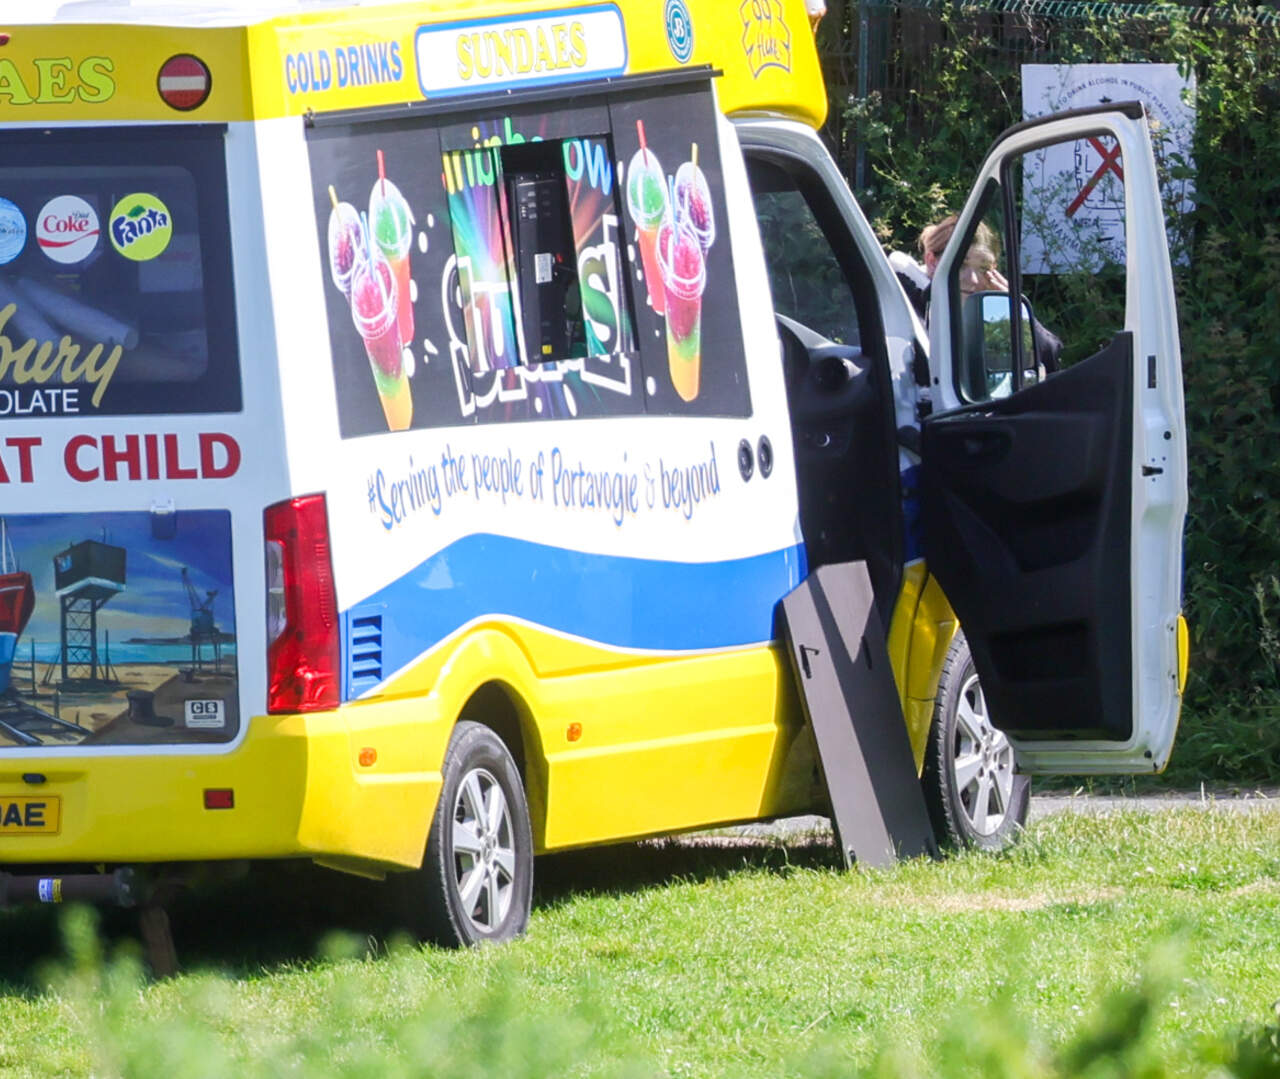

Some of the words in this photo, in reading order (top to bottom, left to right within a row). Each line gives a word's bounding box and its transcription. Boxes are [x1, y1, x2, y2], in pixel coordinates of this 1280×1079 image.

[286, 50, 331, 94] COLD
[335, 40, 403, 87] DRINKS
[456, 22, 588, 81] SUNDAES
[43, 215, 89, 234] Coke
[111, 209, 168, 249] Fanta
[64, 431, 241, 482] CHILD
[367, 454, 441, 530] #Serving
[441, 443, 469, 497] the
[471, 447, 524, 505] people
[530, 451, 545, 501] of
[551, 447, 639, 527] Portavogie
[659, 440, 721, 520] beyond
